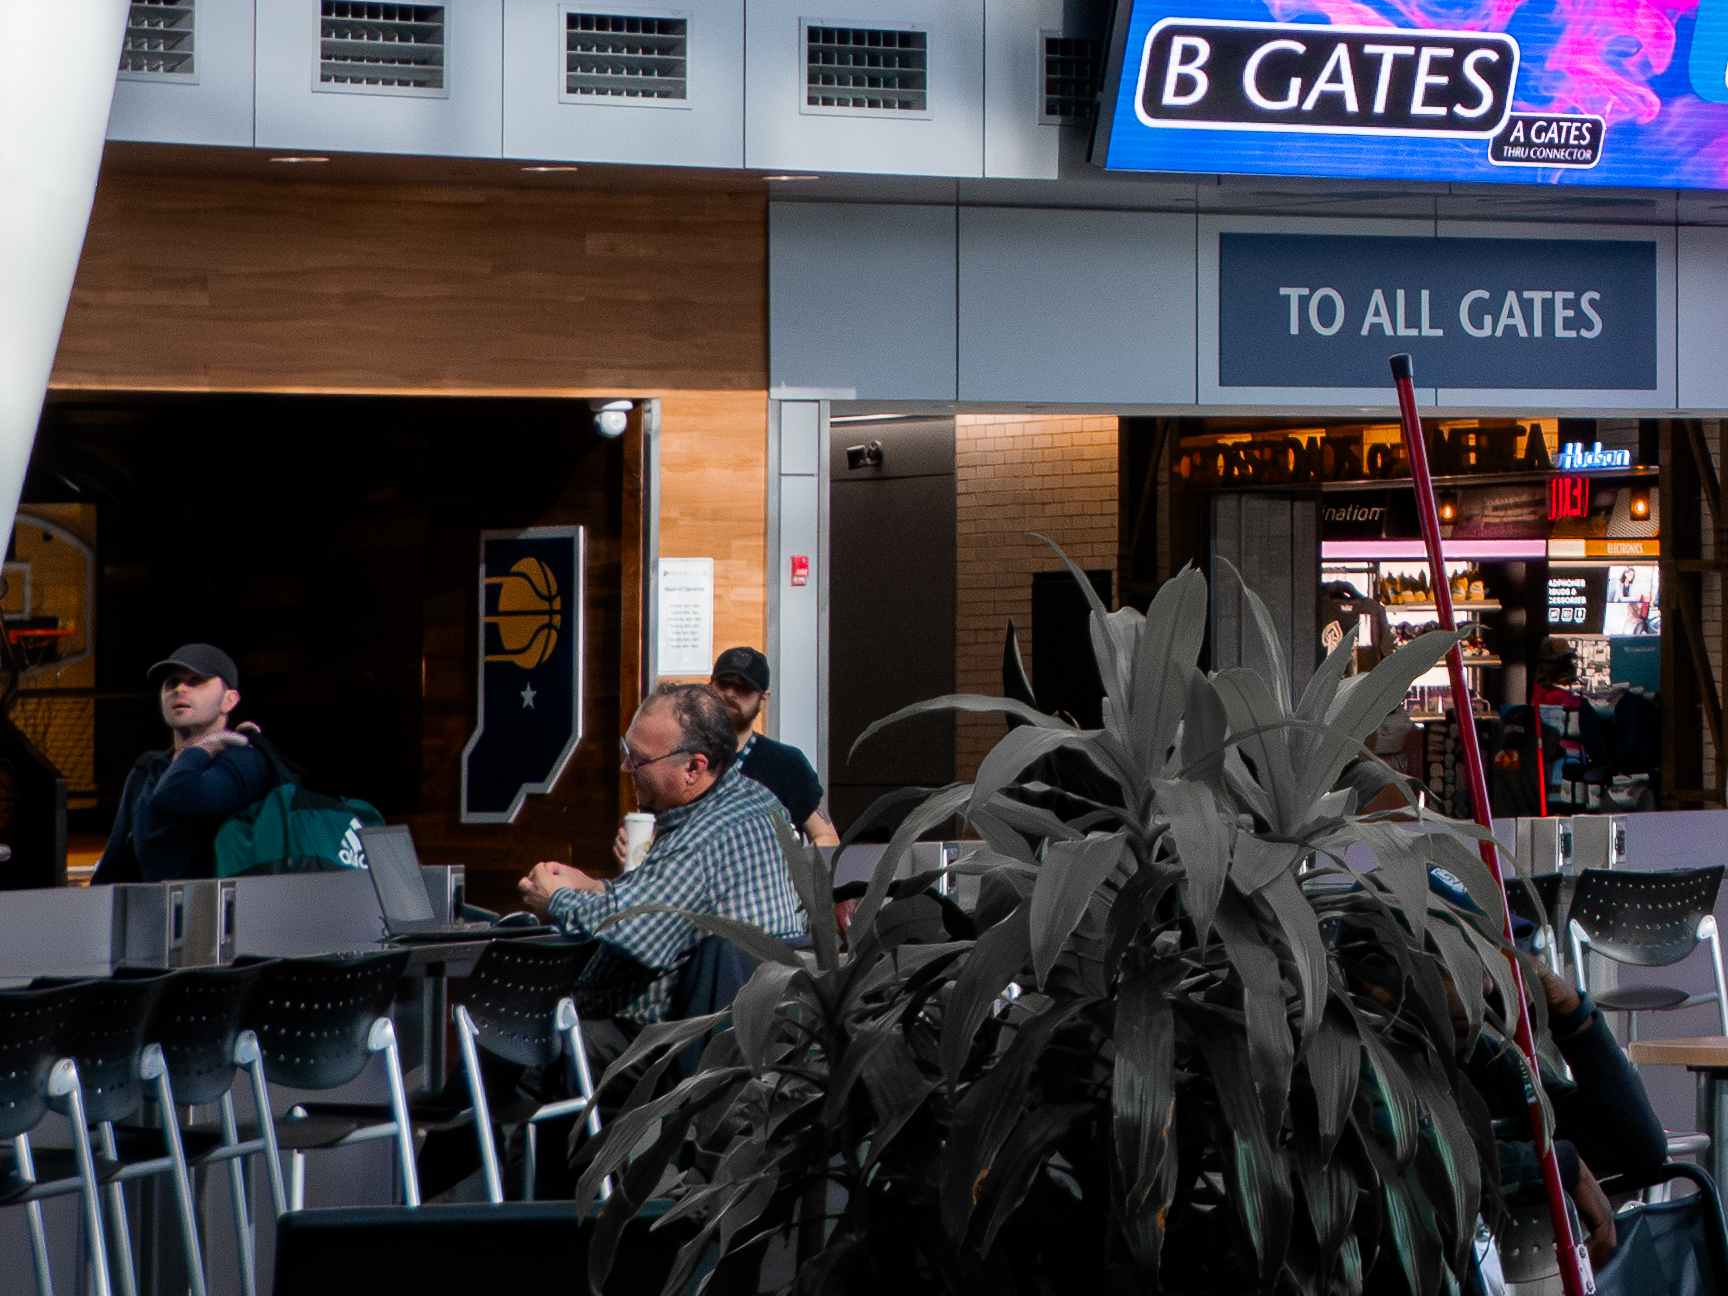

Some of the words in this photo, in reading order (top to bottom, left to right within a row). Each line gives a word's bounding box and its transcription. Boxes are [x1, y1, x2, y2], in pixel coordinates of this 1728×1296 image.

[1161, 35, 1210, 107] B
[1242, 37, 1502, 119] GATES
[1509, 119, 1524, 143] A
[1530, 120, 1593, 146] GATES
[1503, 145, 1529, 159] THRU
[1529, 146, 1593, 161] CONNECTOR
[1279, 286, 1346, 337] TO
[1361, 288, 1443, 338] ALL
[1458, 290, 1604, 339] GATES
[1606, 542, 1644, 555] ELECTRONICS
